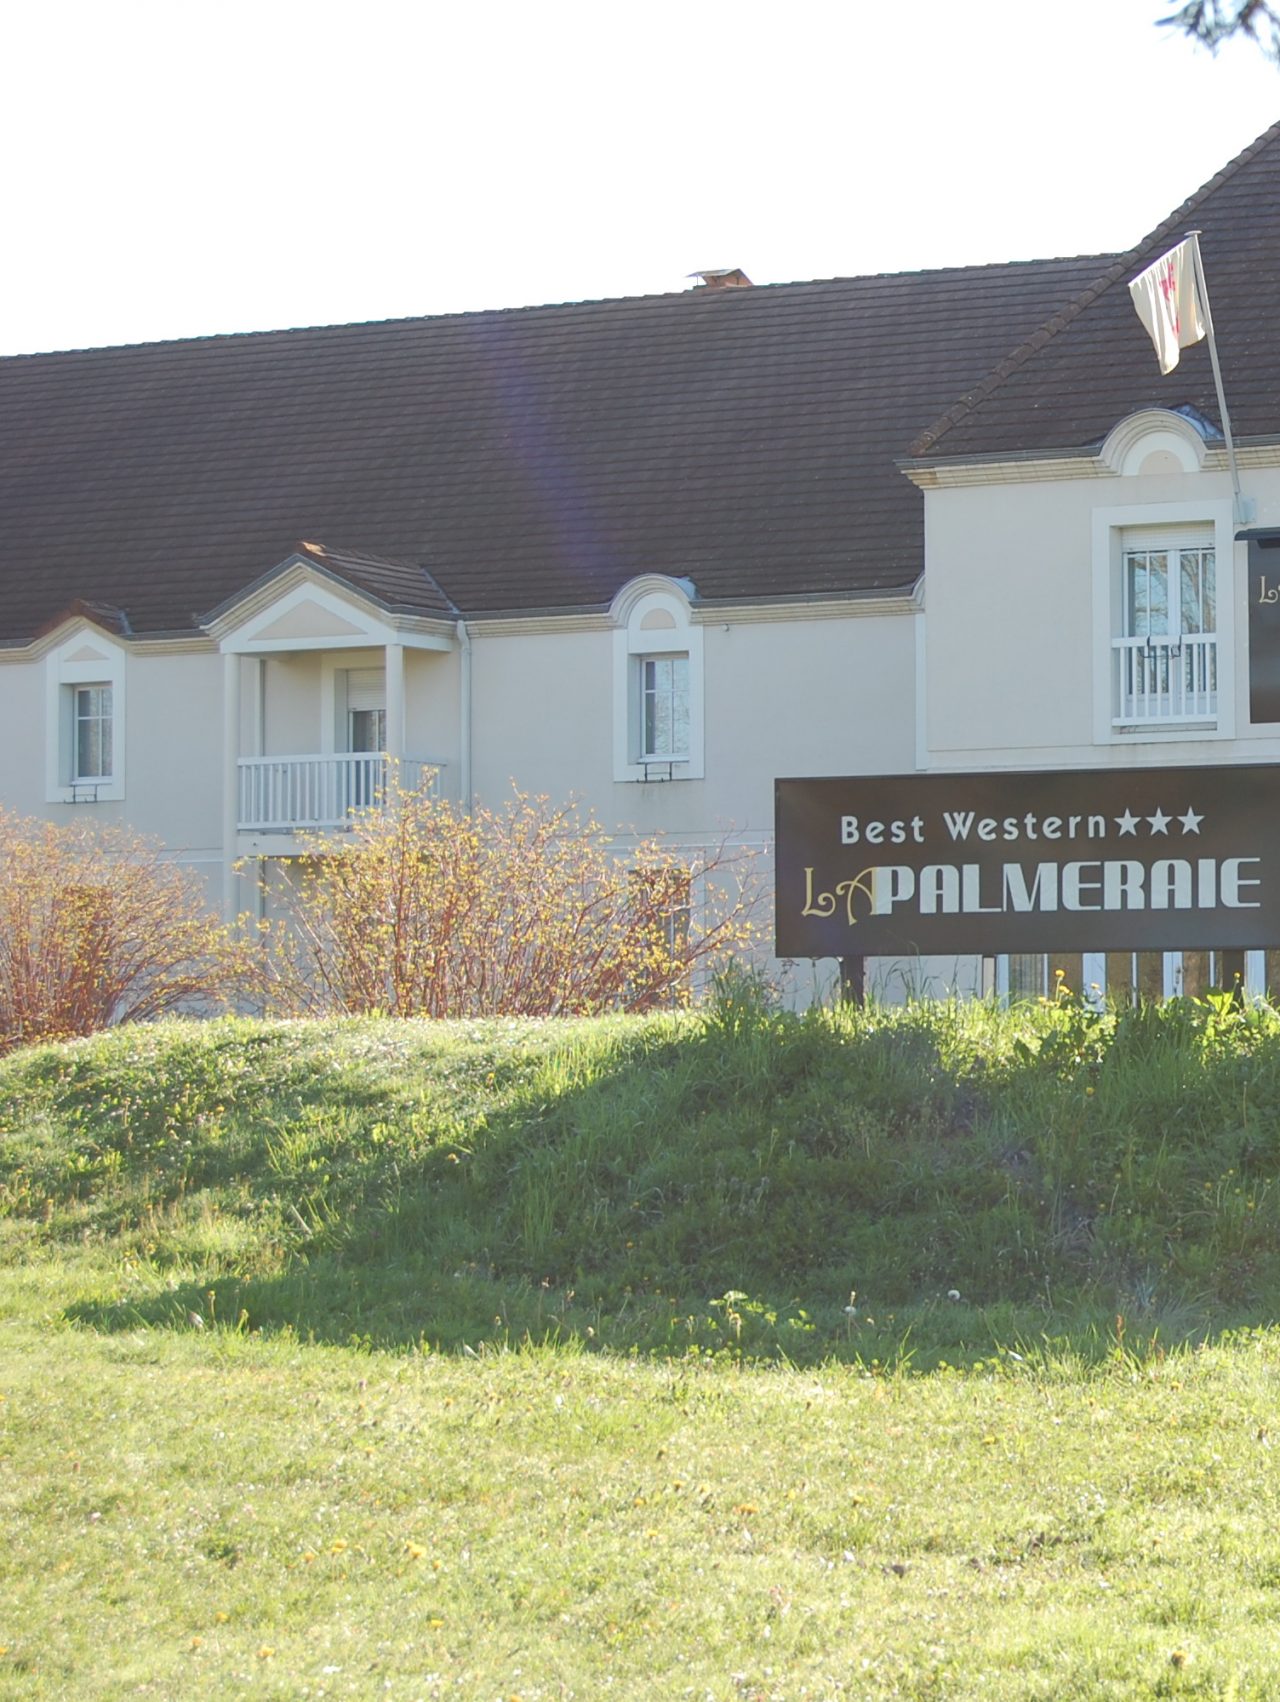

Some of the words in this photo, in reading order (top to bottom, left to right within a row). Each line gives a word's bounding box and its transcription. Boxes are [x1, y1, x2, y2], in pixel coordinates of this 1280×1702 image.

[841, 815, 924, 845] Best
[943, 810, 1106, 841] Western
[874, 858, 1261, 915] PALMERAIE
